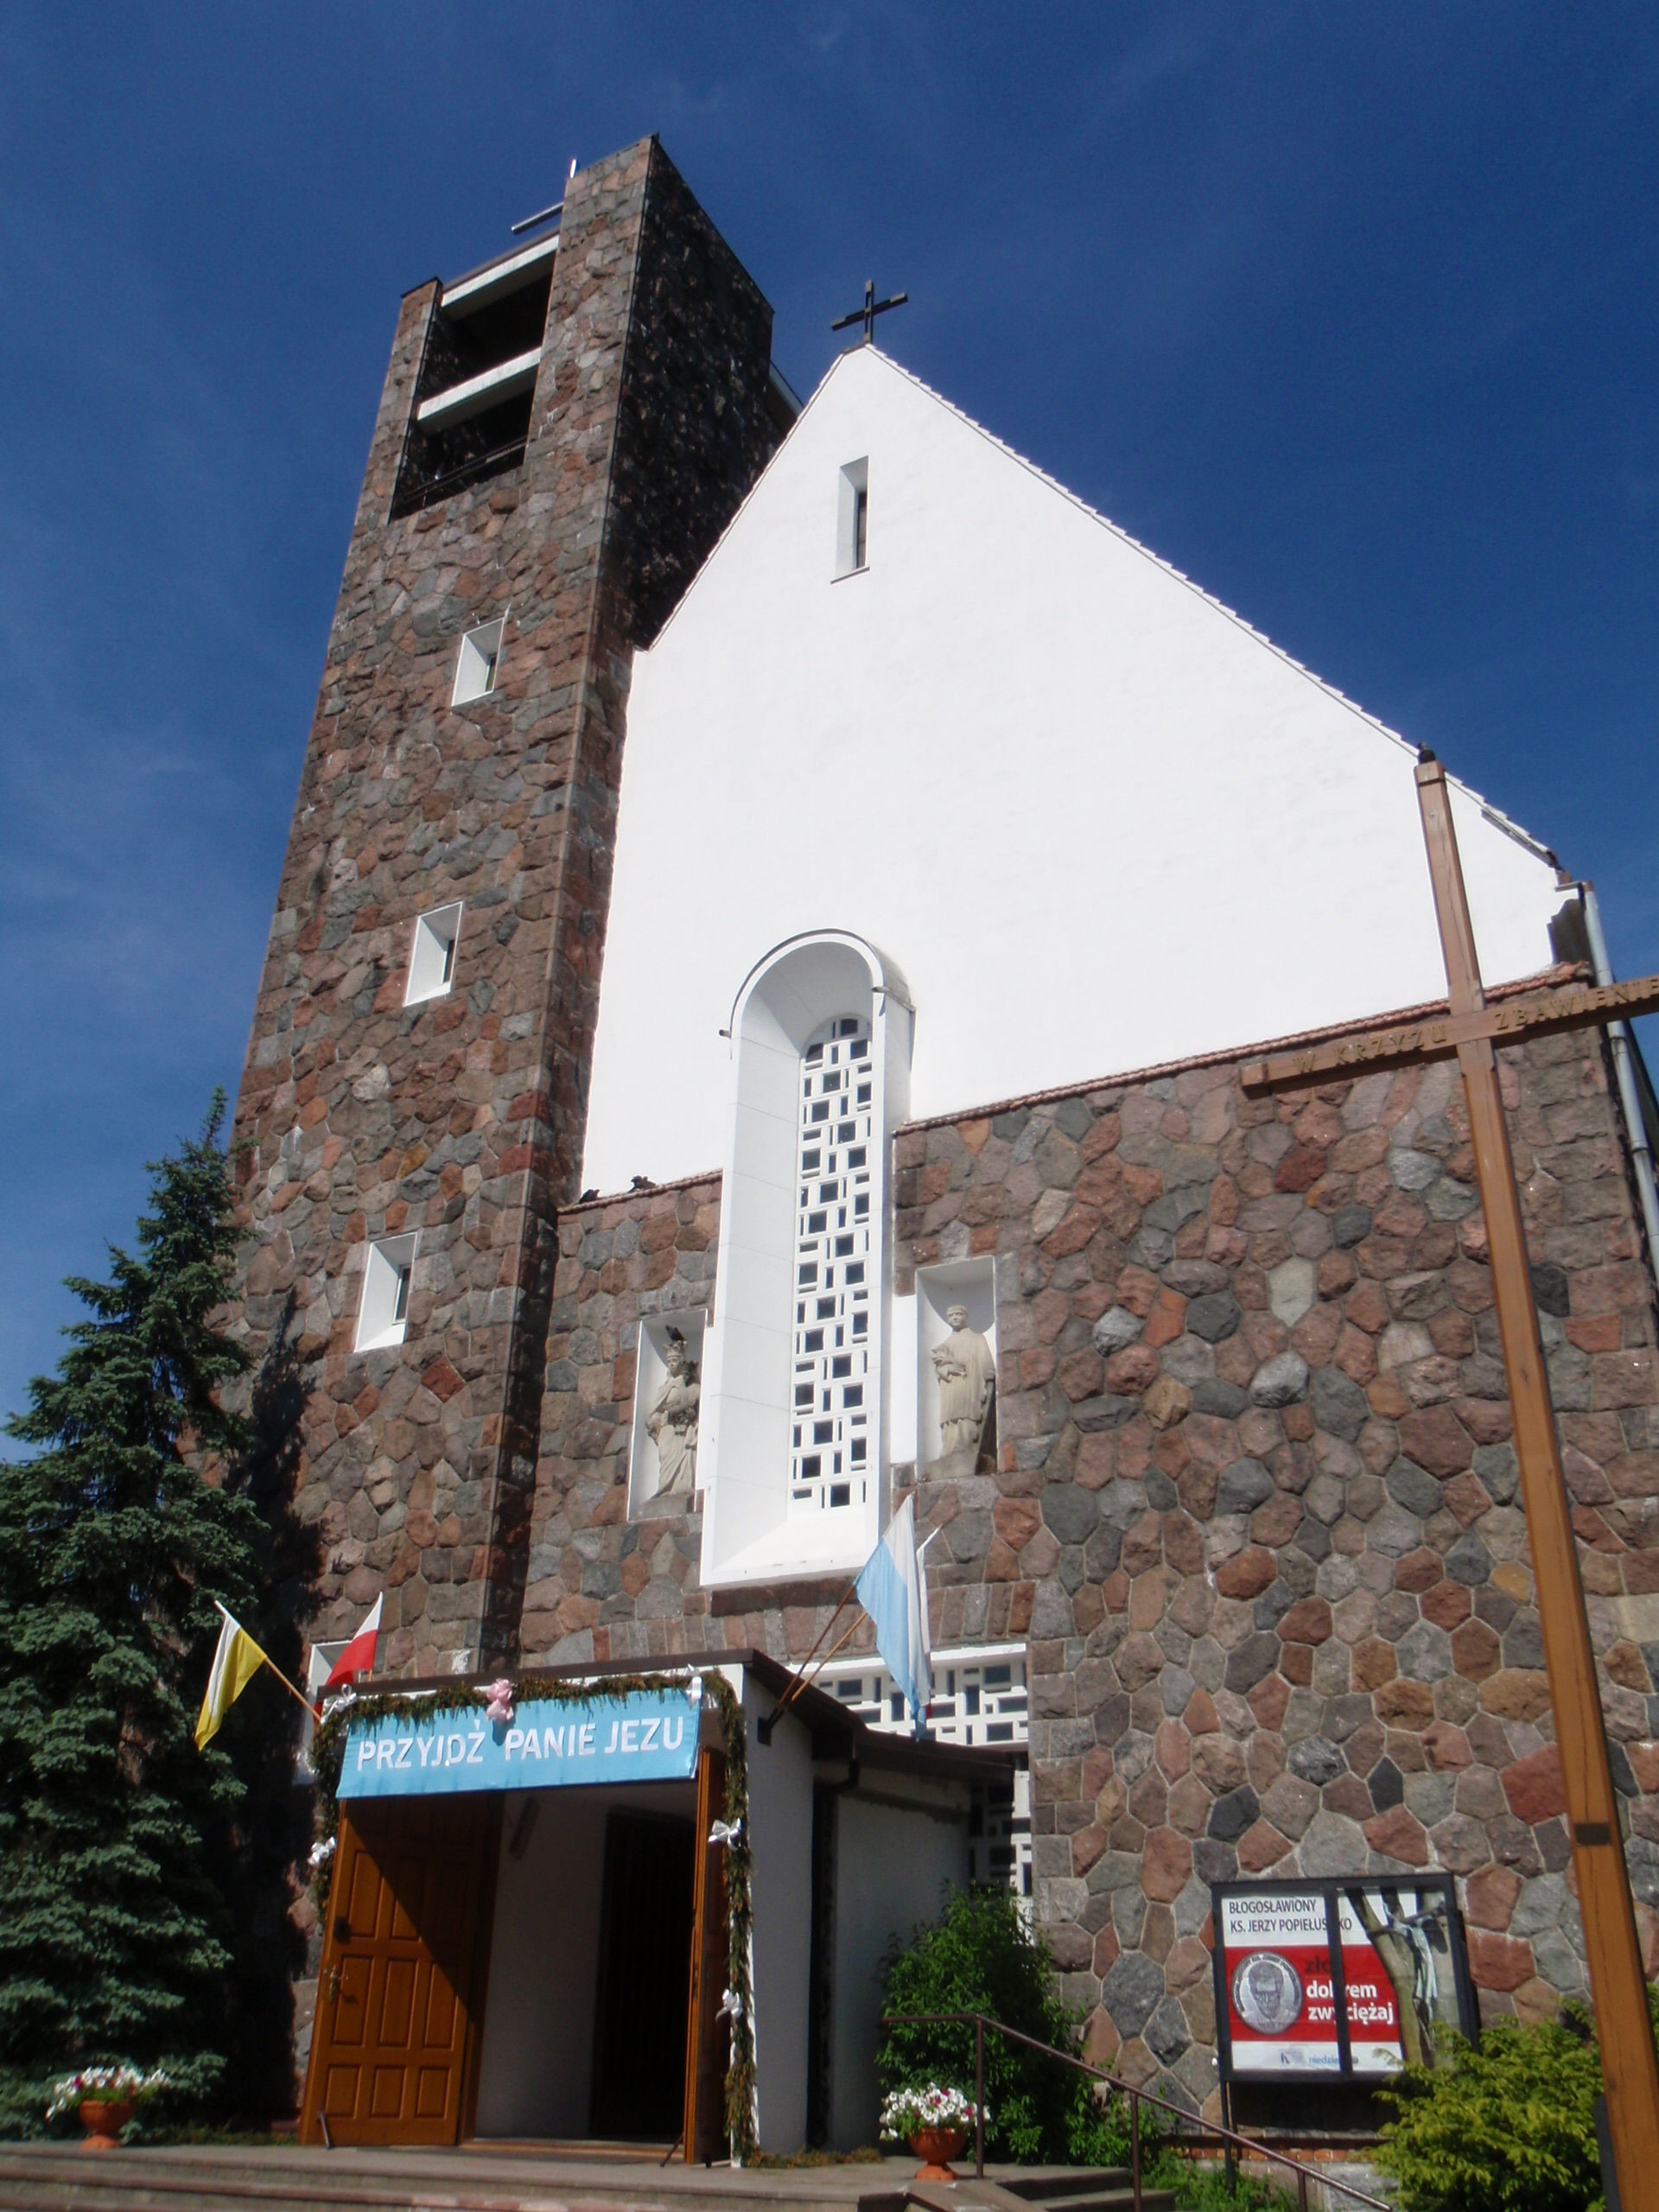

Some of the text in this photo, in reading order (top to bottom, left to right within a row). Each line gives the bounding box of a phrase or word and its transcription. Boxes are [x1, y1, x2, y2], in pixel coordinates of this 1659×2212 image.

[1292, 1051, 1316, 1073] W
[504, 1723, 597, 1761] PANIE
[604, 1716, 684, 1755] JEZU
[1229, 1899, 1316, 1914] BŁOGOSŁAWIONY
[1230, 1917, 1353, 1933] KS. JERZY POPIEŁUSKO
